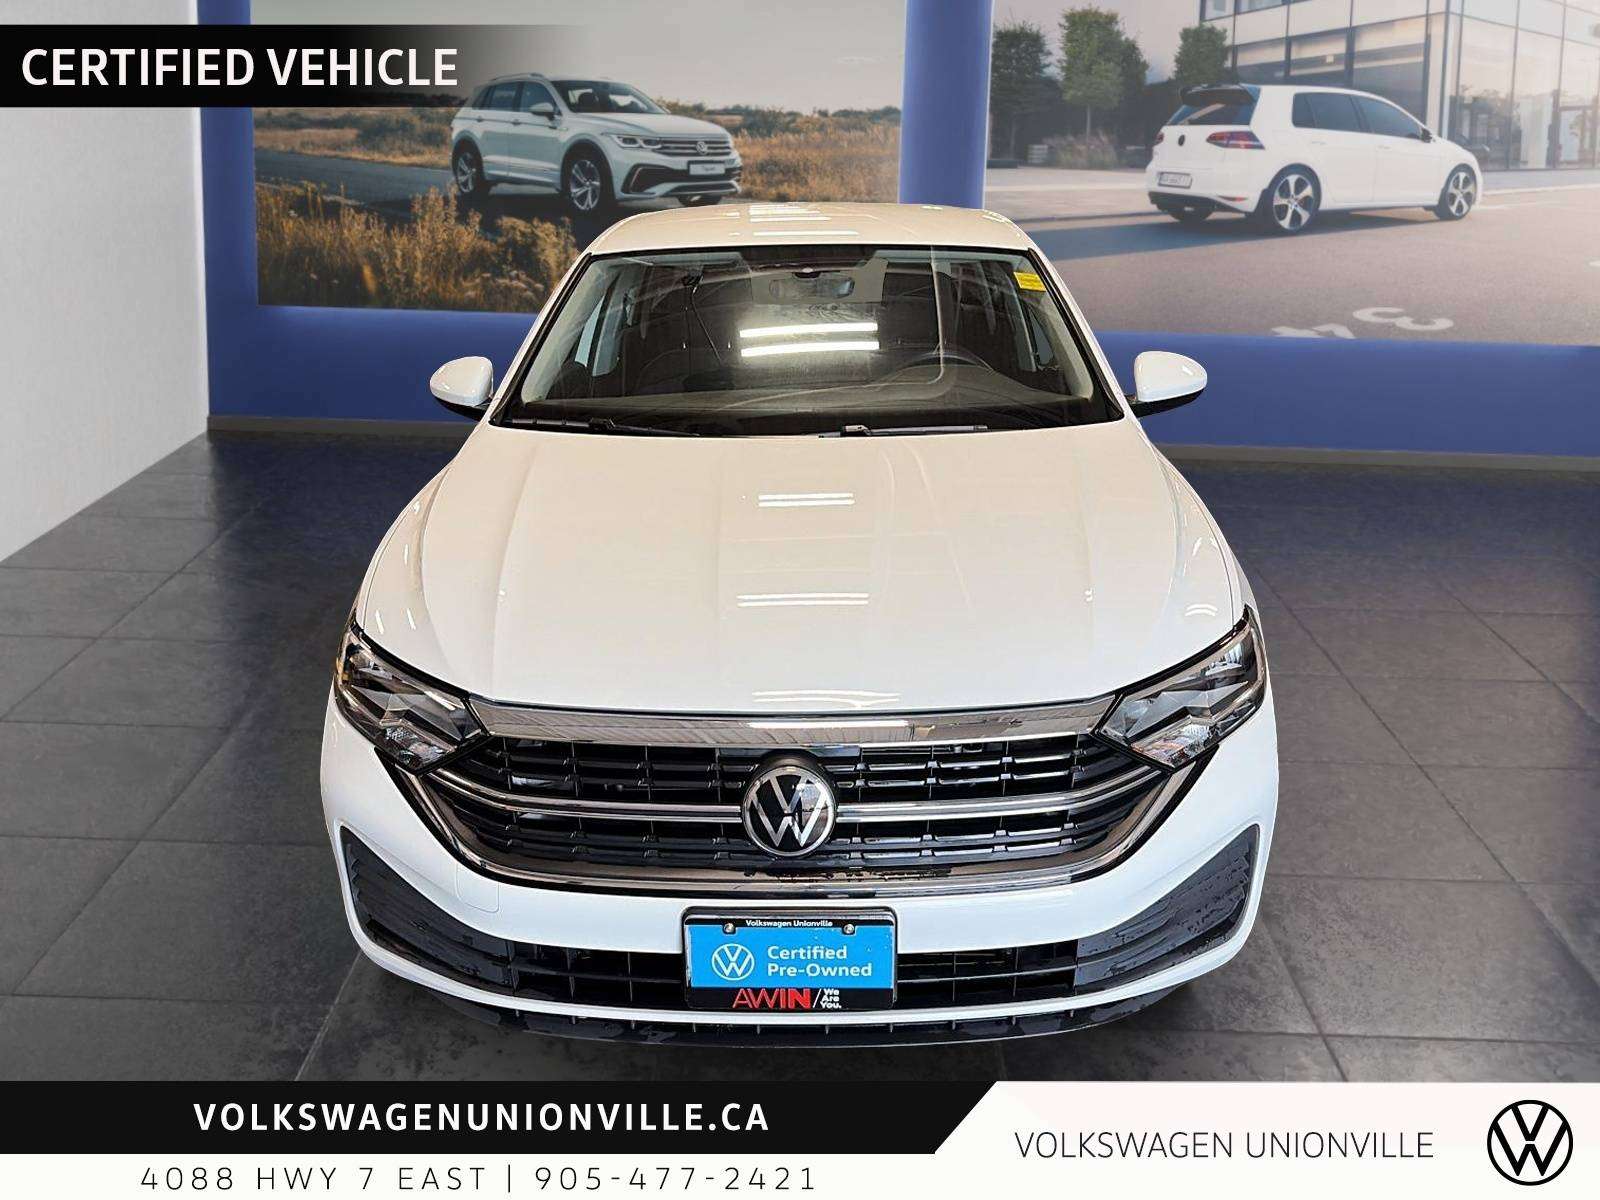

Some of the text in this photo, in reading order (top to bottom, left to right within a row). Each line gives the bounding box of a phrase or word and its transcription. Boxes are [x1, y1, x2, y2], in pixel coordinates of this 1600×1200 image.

[745, 920, 791, 928] Volkswagen
[767, 945, 847, 960] Certified
[767, 962, 872, 977] Pre-Owned
[823, 988, 840, 996] We
[732, 988, 811, 1009] AWIN
[820, 1001, 842, 1009] You.
